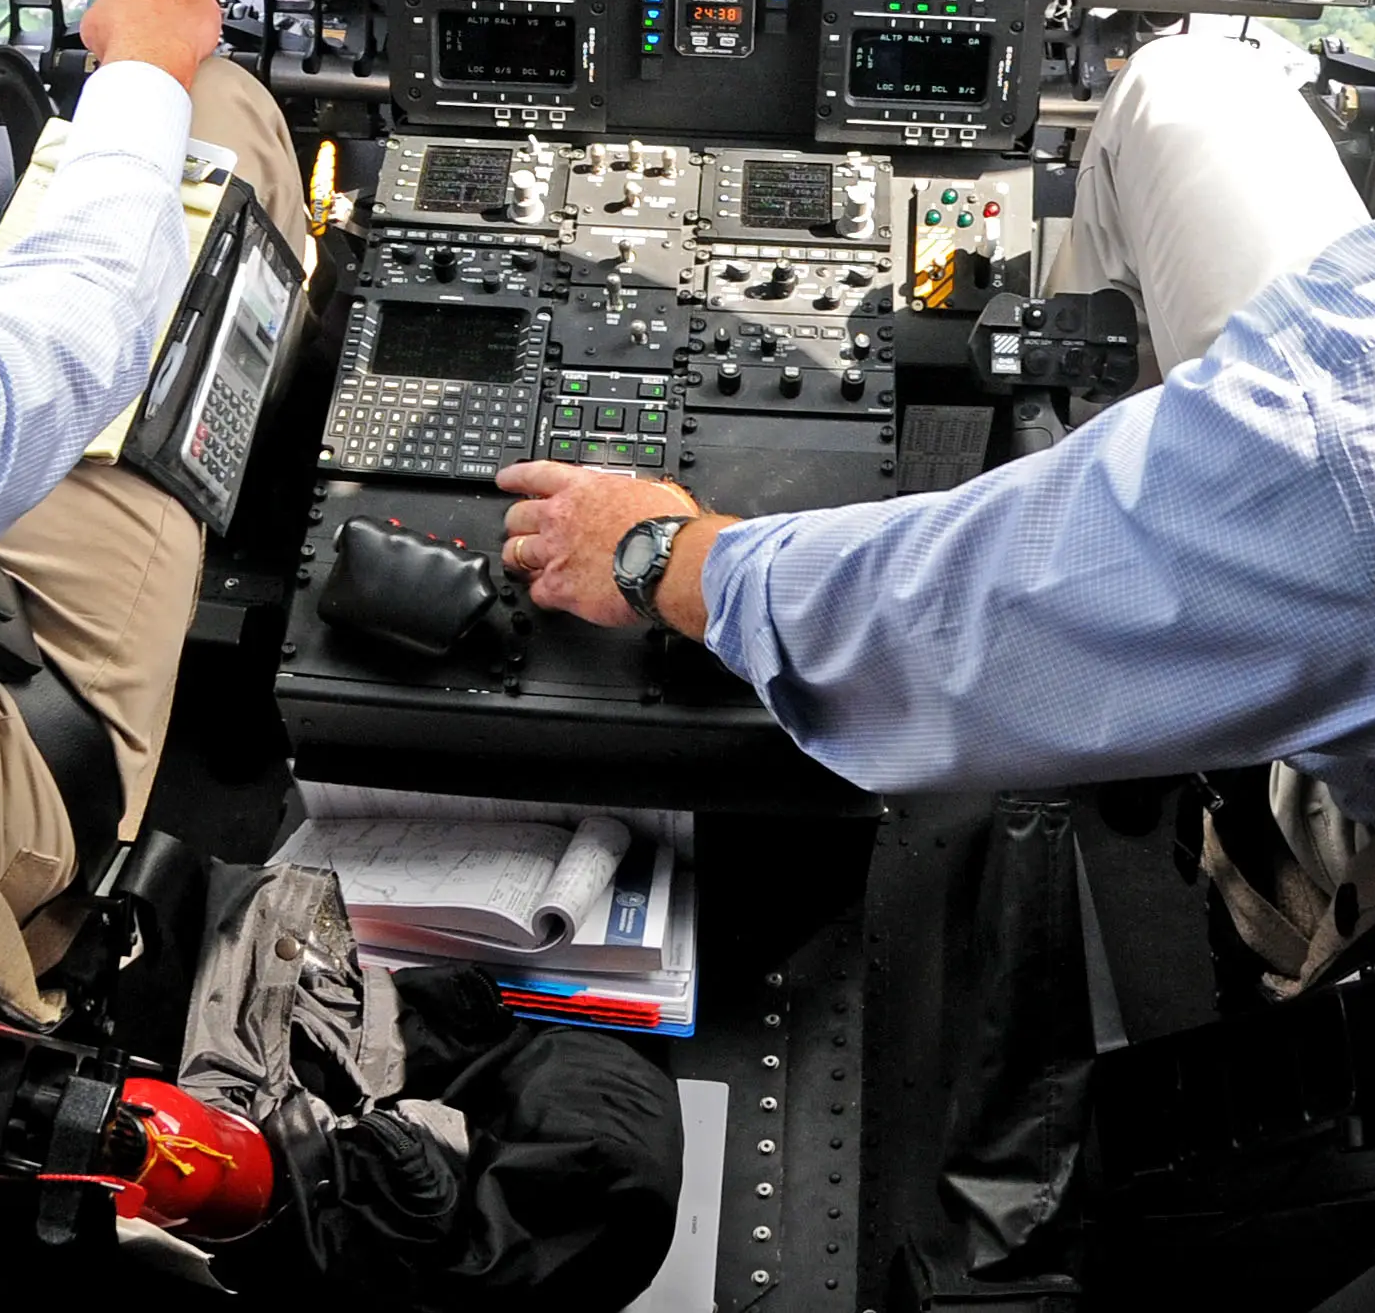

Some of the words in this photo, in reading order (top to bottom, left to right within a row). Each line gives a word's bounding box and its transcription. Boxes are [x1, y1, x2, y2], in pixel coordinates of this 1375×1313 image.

[694, 6, 737, 21] 24:38
[876, 83, 893, 91] LOC
[462, 464, 493, 475] ENTER
